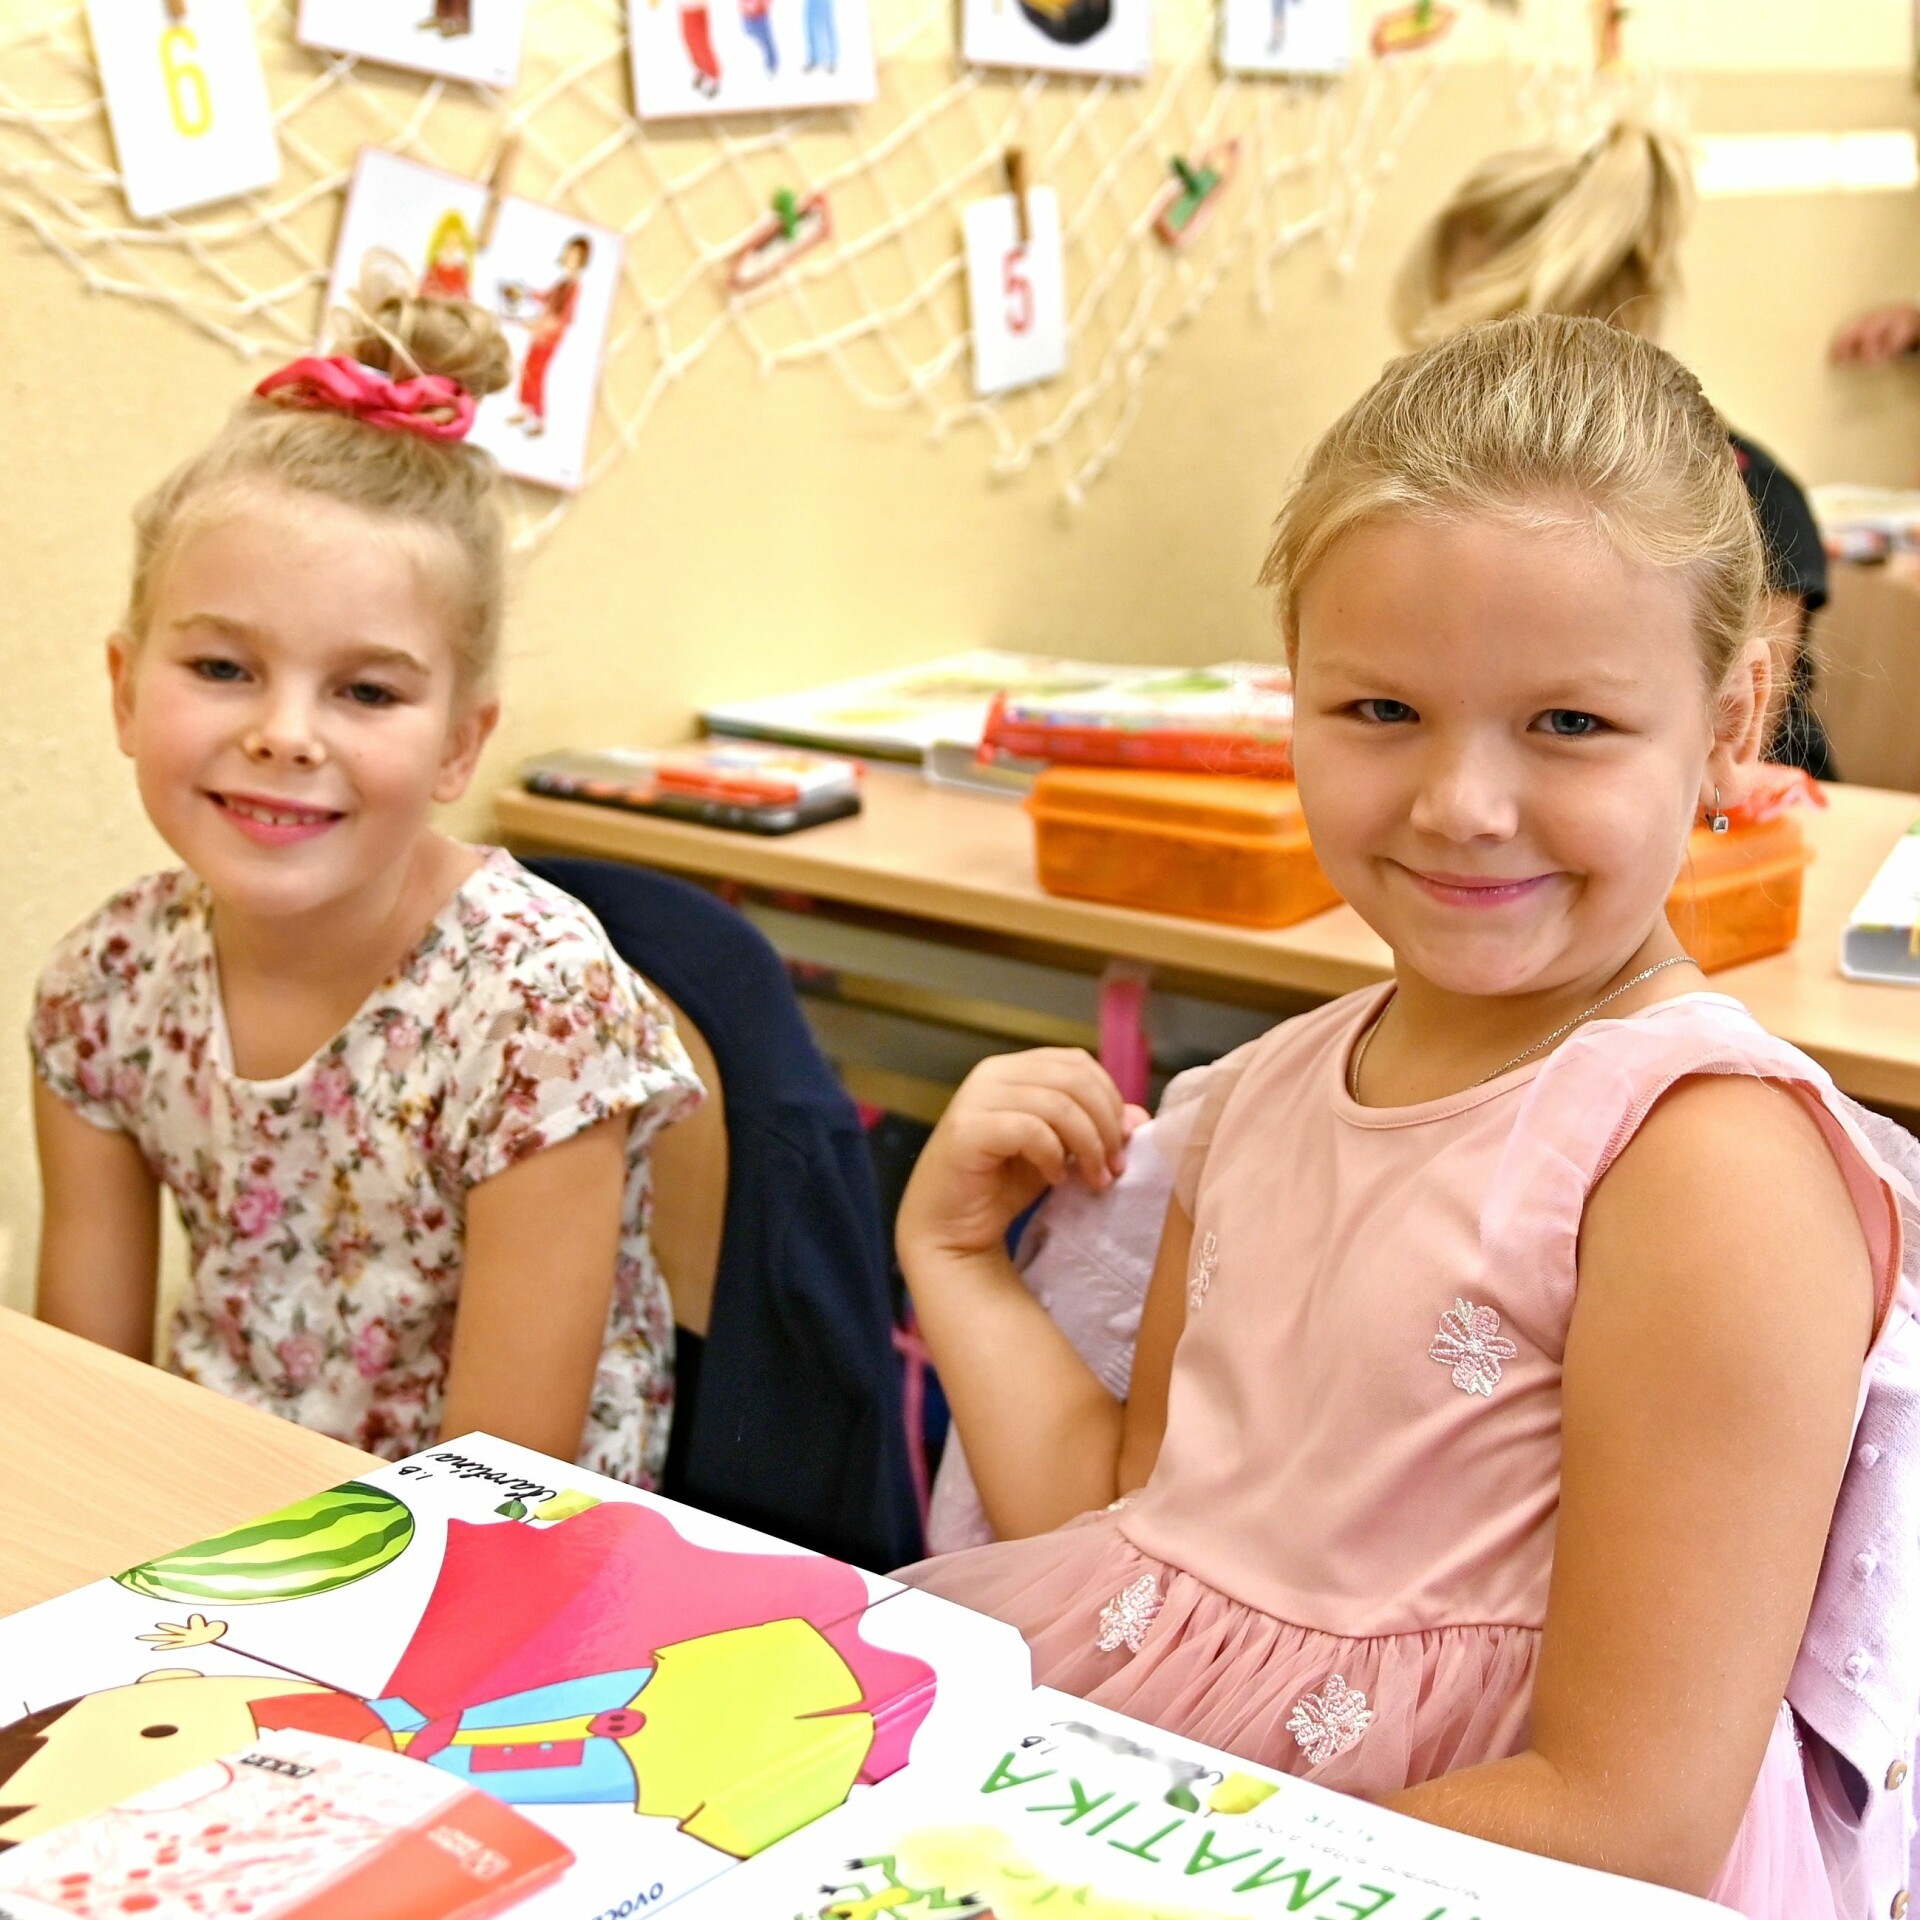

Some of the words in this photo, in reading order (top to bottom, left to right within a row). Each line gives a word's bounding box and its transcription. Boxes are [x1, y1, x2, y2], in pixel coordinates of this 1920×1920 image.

[160, 25, 214, 138] 6
[1002, 248, 1035, 334] 5
[980, 1751, 1481, 1920] EMATIKA
